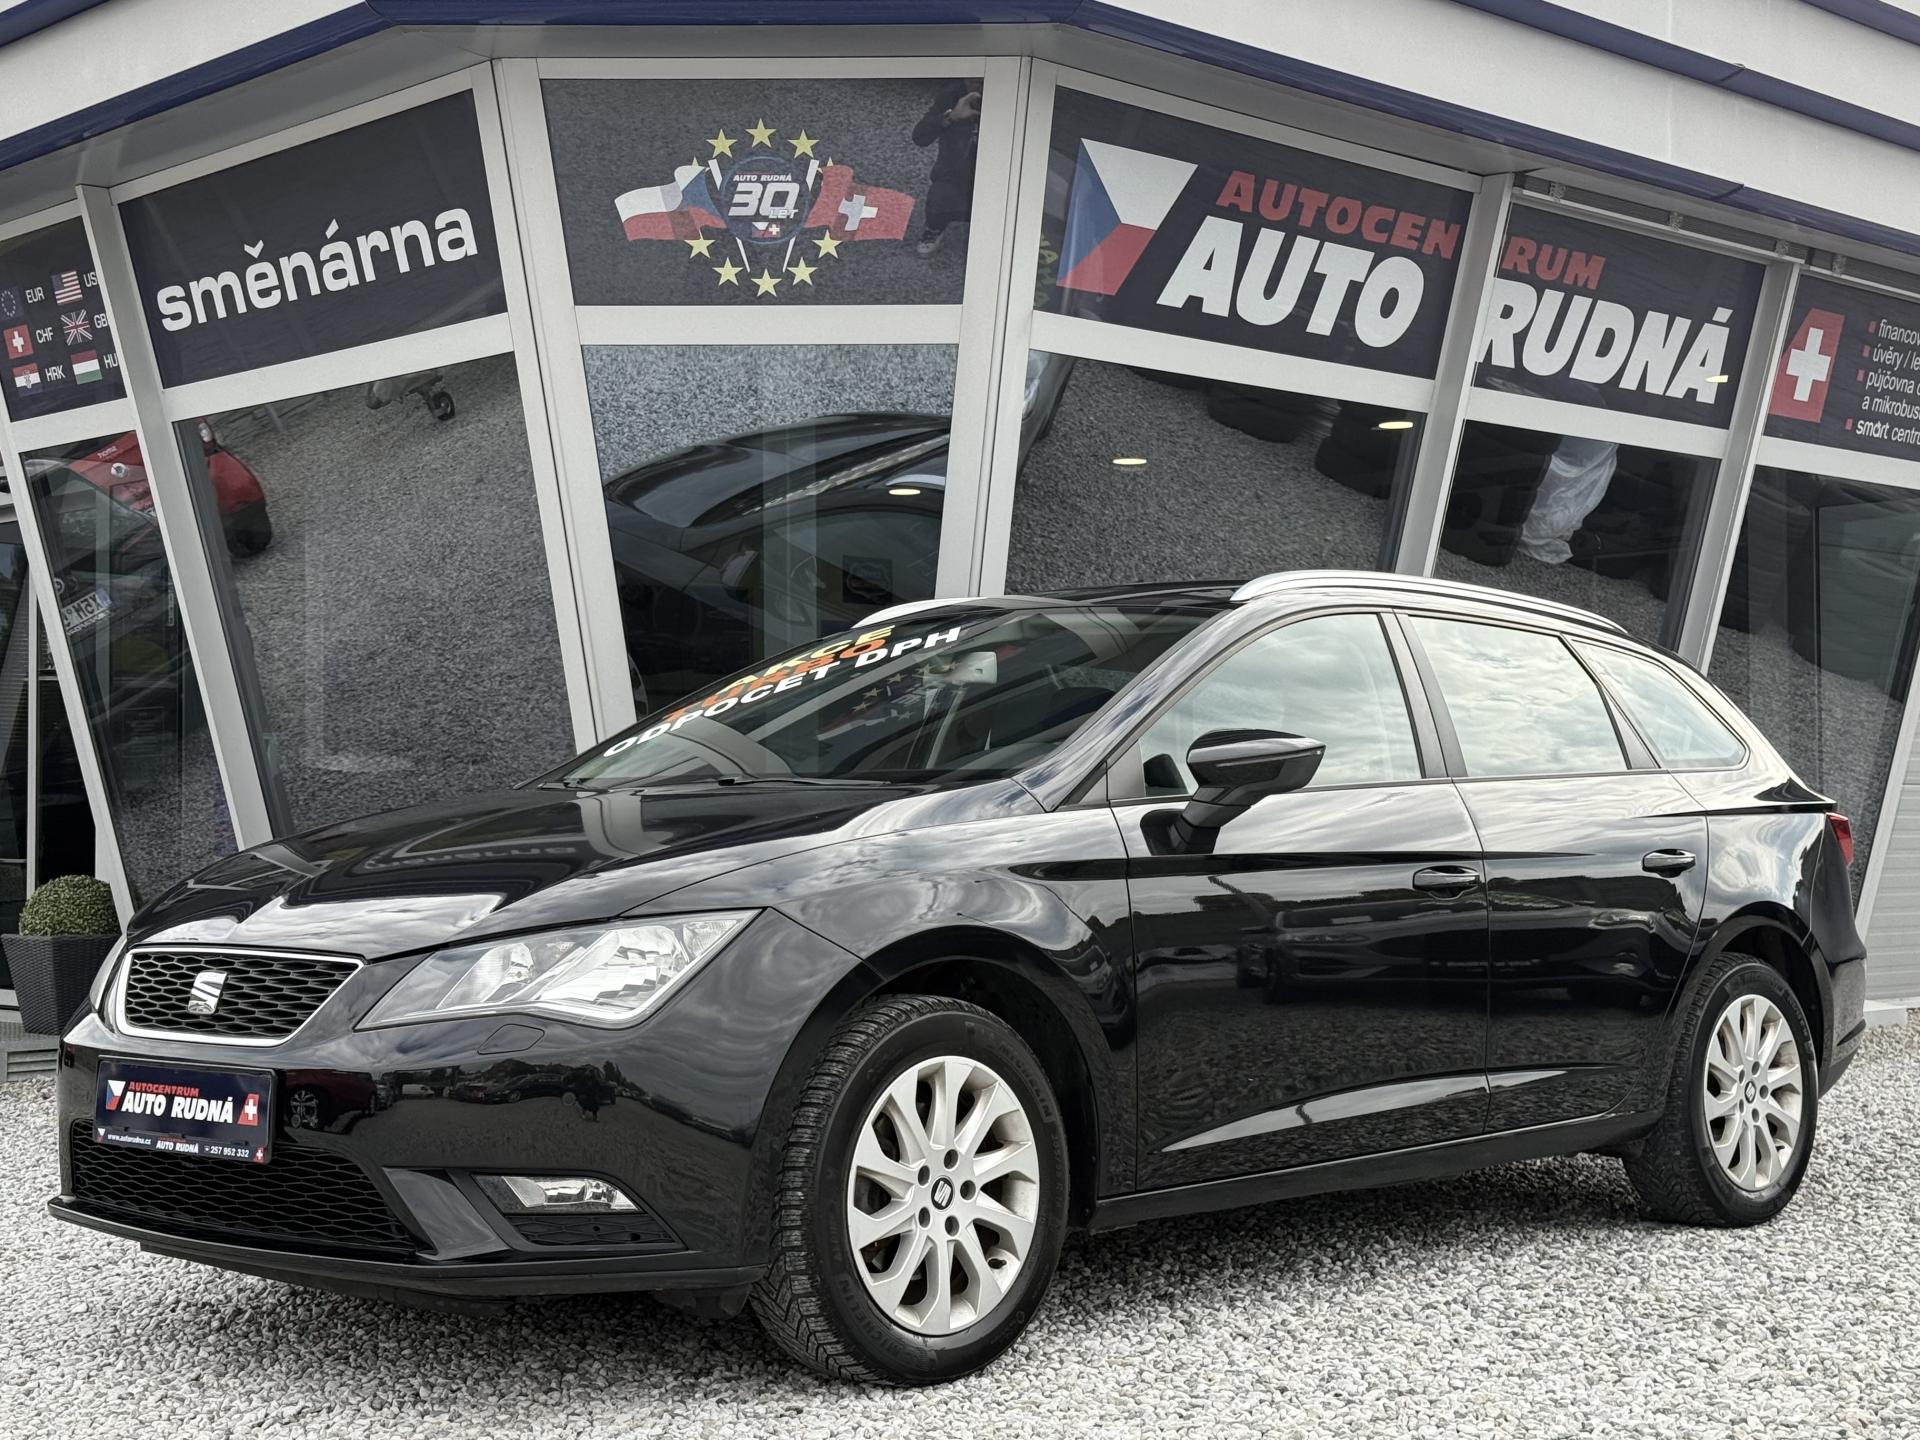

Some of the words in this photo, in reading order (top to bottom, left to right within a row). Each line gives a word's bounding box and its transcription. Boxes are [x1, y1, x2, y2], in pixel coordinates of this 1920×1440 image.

[733, 174, 757, 182] AUTO
[728, 182, 800, 217] 30
[768, 208, 799, 219] LET
[156, 207, 478, 332] směnárna
[25, 286, 45, 304] EUR
[1156, 215, 1424, 348] AUTO
[1477, 276, 1733, 405] RUDNÁ
[35, 326, 54, 344] CHF
[1872, 343, 1904, 371] úvěry
[45, 364, 66, 382] HRK
[1865, 368, 1915, 394] půjčovna
[1861, 395, 1871, 411] a
[1871, 395, 1920, 421] mikrobus
[715, 625, 896, 695] AKCE
[603, 660, 841, 758] ODPOCET
[854, 627, 961, 669] DPH
[128, 1081, 200, 1098] AUTOCENTRUM
[121, 1091, 167, 1117] AUTO
[171, 1096, 234, 1124] RUDNÁ
[156, 1140, 174, 1151] AUTO
[175, 1142, 199, 1154] RUDNÁ
